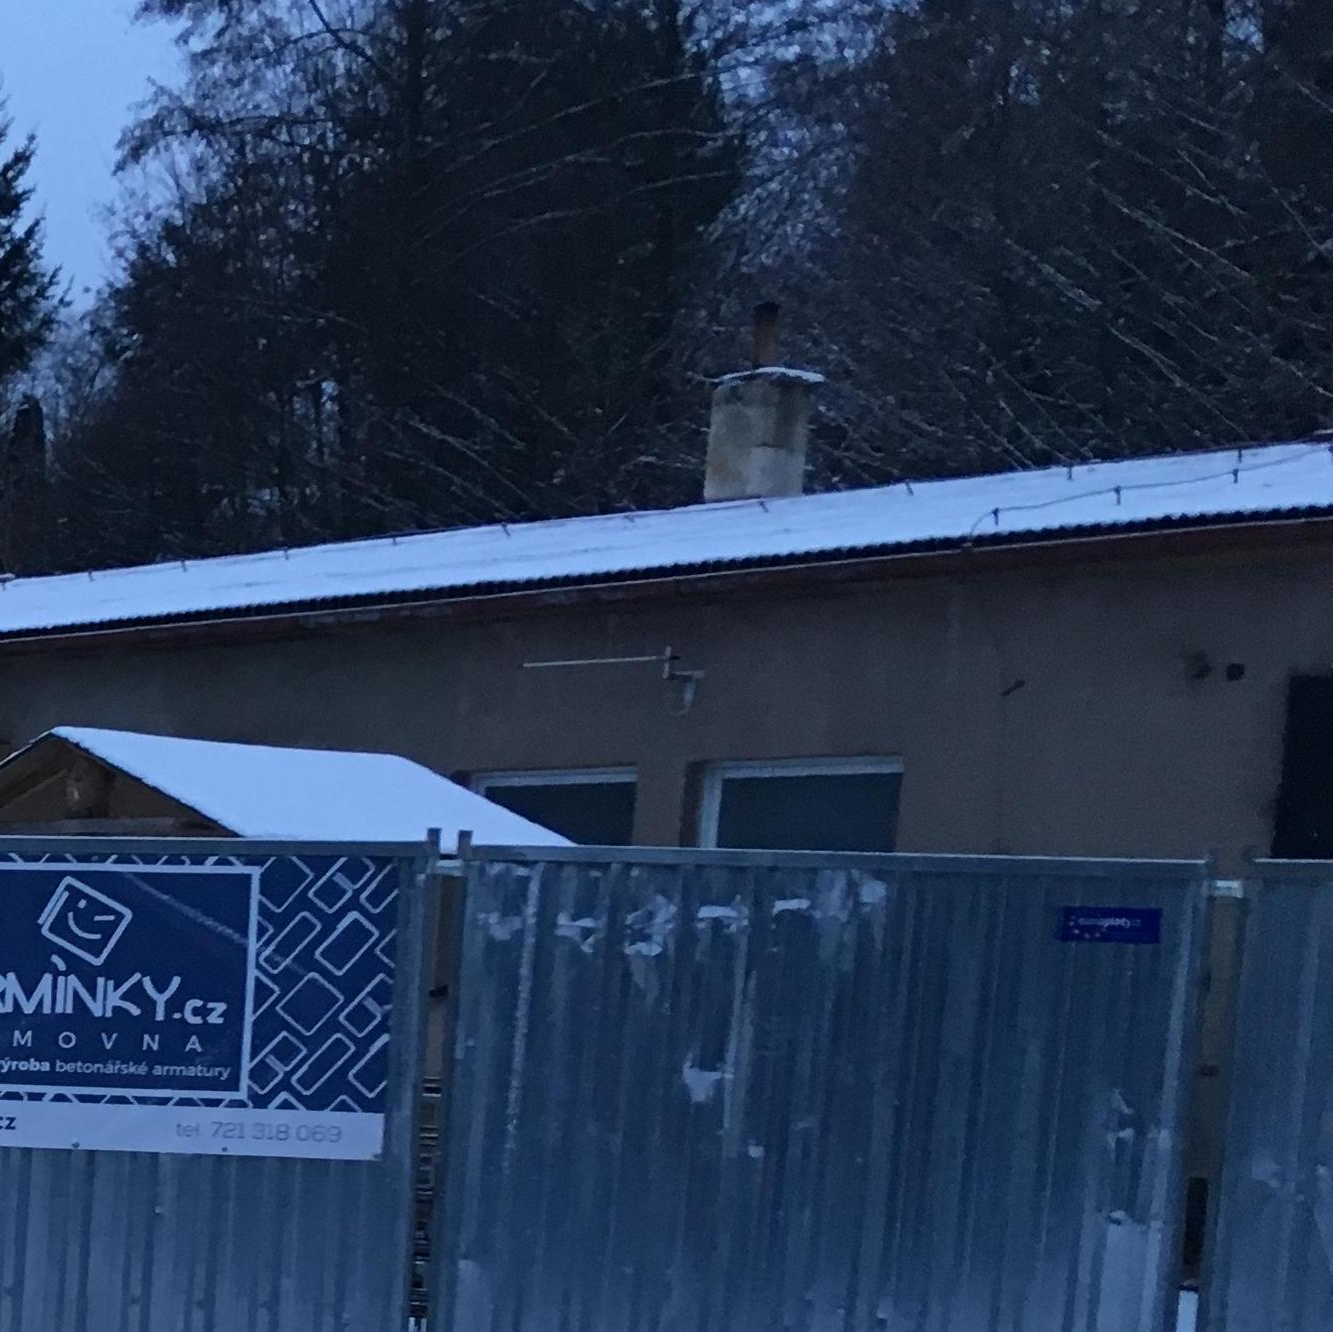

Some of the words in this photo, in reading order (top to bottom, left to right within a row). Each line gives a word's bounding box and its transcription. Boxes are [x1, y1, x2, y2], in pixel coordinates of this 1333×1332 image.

[55, 1059, 148, 1075] betonářské
[152, 1063, 230, 1080] armatury
[211, 1121, 245, 1139] 721
[252, 1122, 290, 1141] 318
